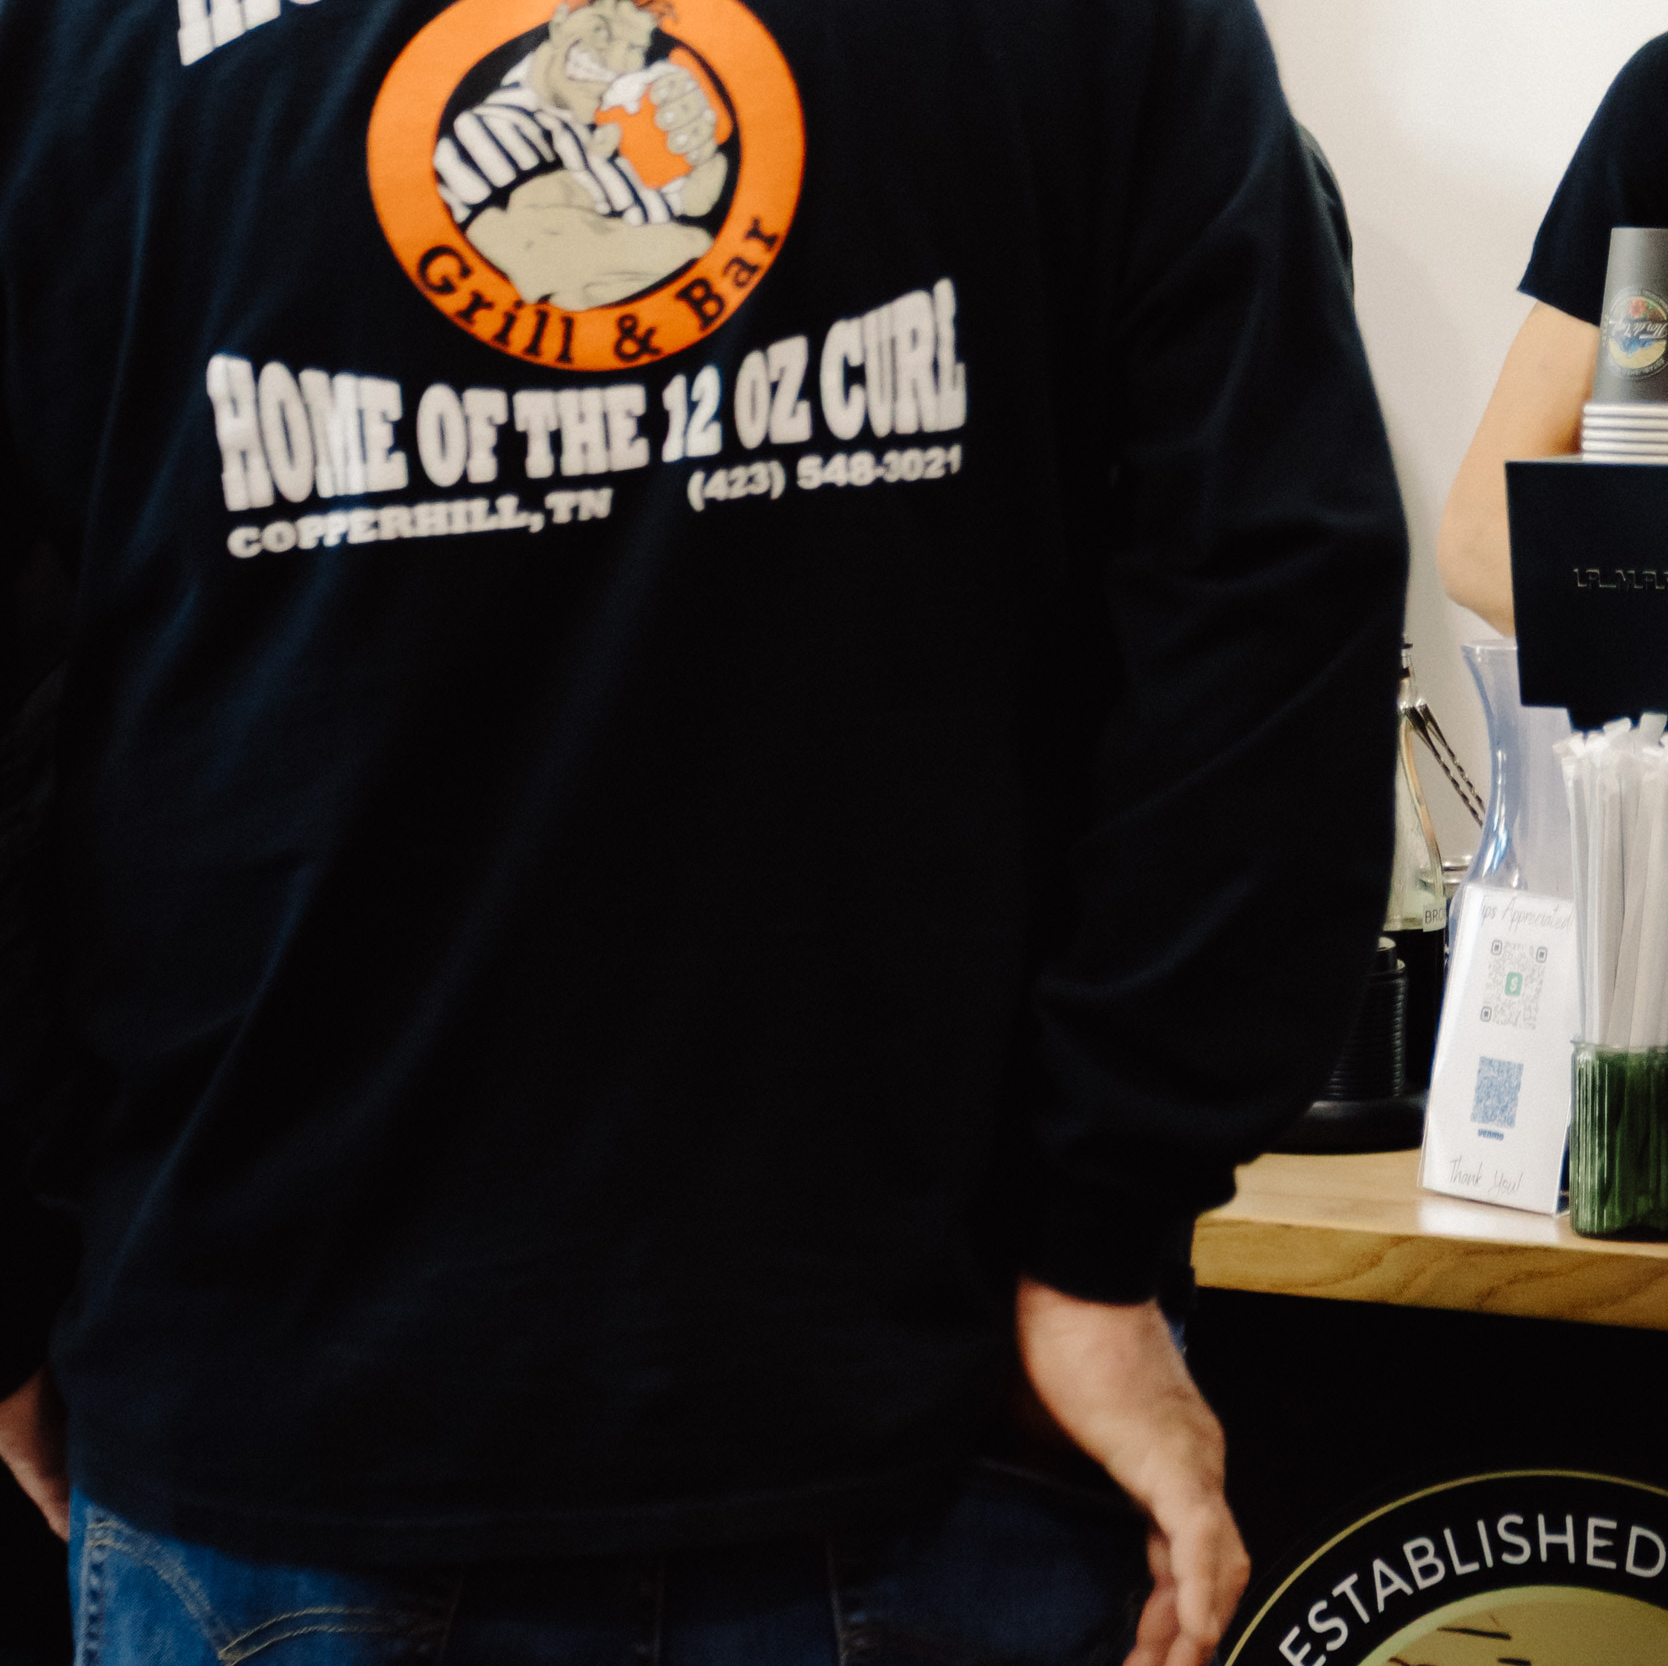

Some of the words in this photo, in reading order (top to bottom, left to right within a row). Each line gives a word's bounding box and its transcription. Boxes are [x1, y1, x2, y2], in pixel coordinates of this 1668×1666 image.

[416, 245, 574, 364] Grill
[614, 313, 663, 363] &
[676, 216, 779, 330] Bar
[206, 353, 409, 512] HOME
[416, 383, 509, 487] OF
[513, 383, 651, 480] THE
[662, 364, 724, 463] 12
[734, 335, 812, 451] OZ
[819, 277, 968, 442] CURL
[544, 488, 614, 525] TN
[687, 460, 786, 512] (423)
[1450, 1154, 1483, 1187] Thank
